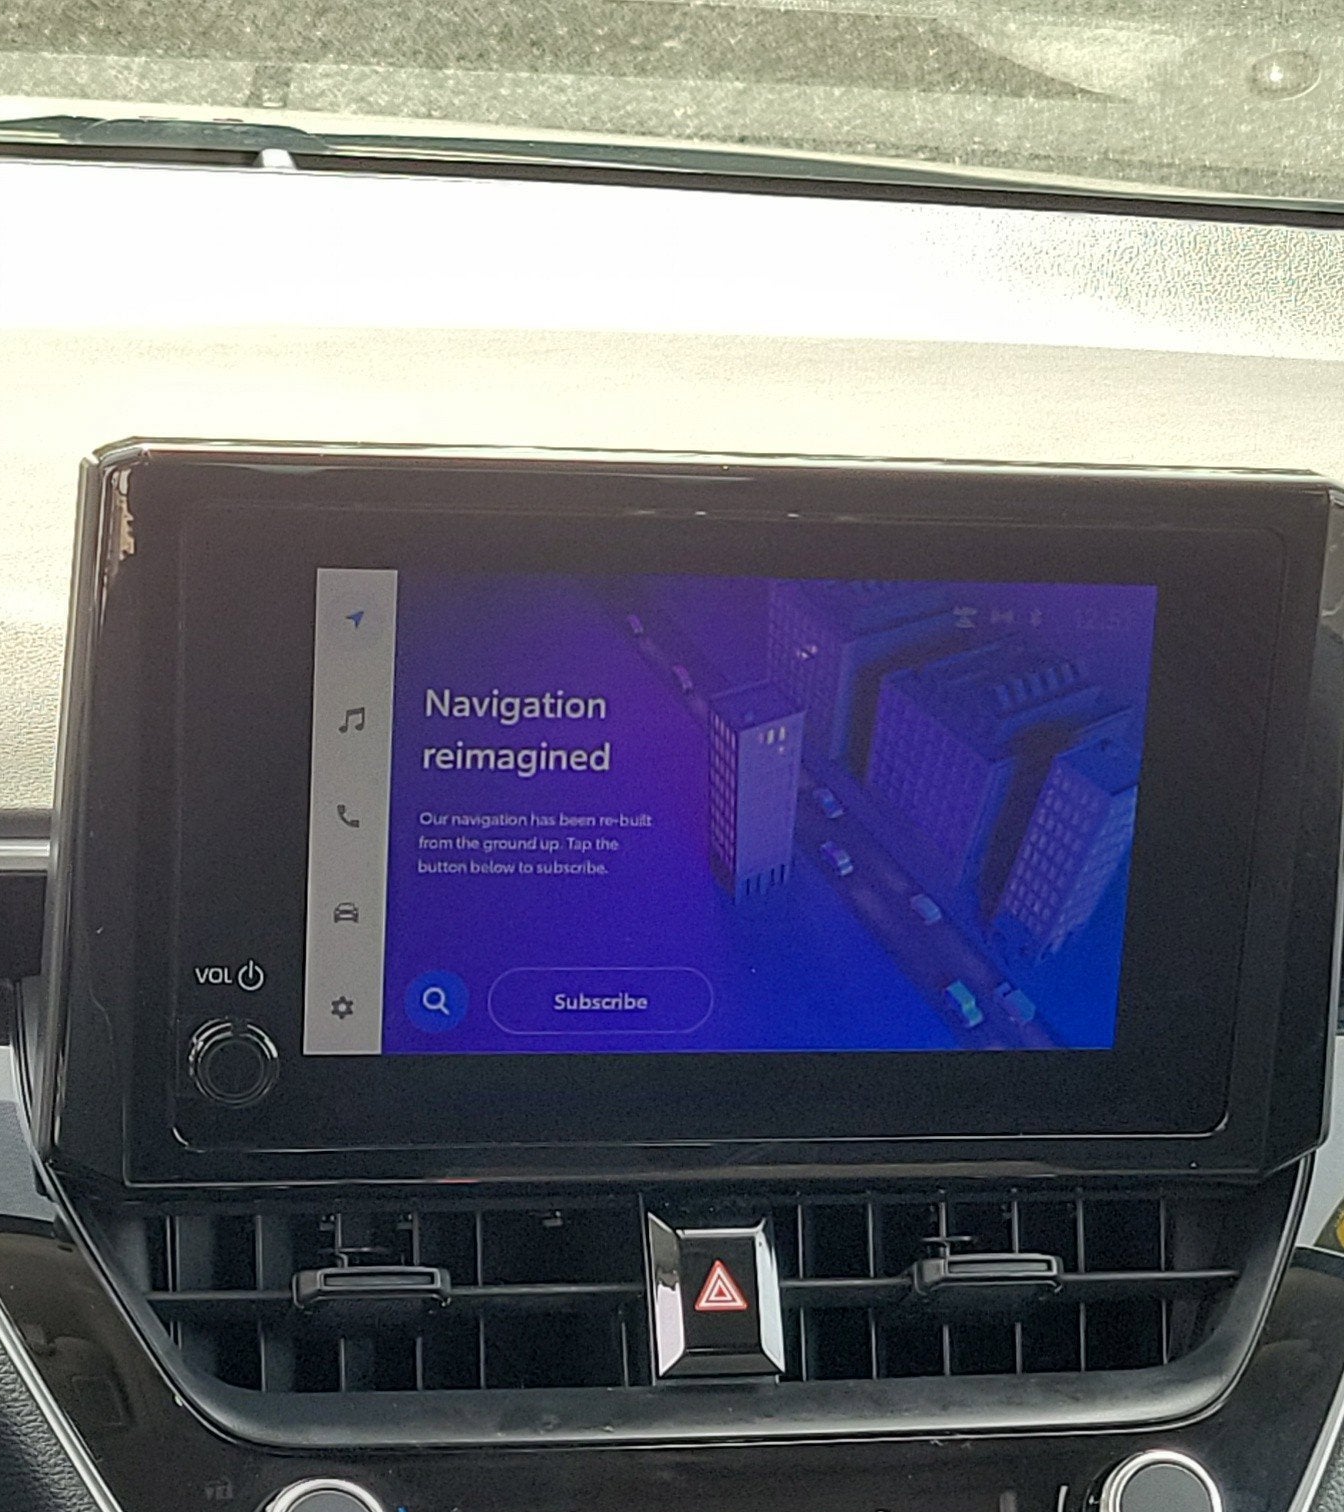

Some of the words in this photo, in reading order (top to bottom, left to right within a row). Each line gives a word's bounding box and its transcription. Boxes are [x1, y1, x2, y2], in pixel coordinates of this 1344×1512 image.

[425, 688, 606, 726] Navigation
[422, 740, 611, 778] reimagined
[419, 812, 449, 826] Our
[451, 812, 528, 829] navigation
[530, 812, 556, 827] has
[558, 812, 597, 828] been
[418, 836, 453, 850] from
[455, 836, 480, 850] the
[482, 836, 538, 853] ground
[566, 837, 593, 853] Tap
[594, 837, 620, 851] the
[417, 859, 468, 874] button
[469, 860, 515, 874] below
[518, 861, 534, 875] to
[195, 966, 233, 985] VOL
[553, 991, 648, 1011] Subscribe
